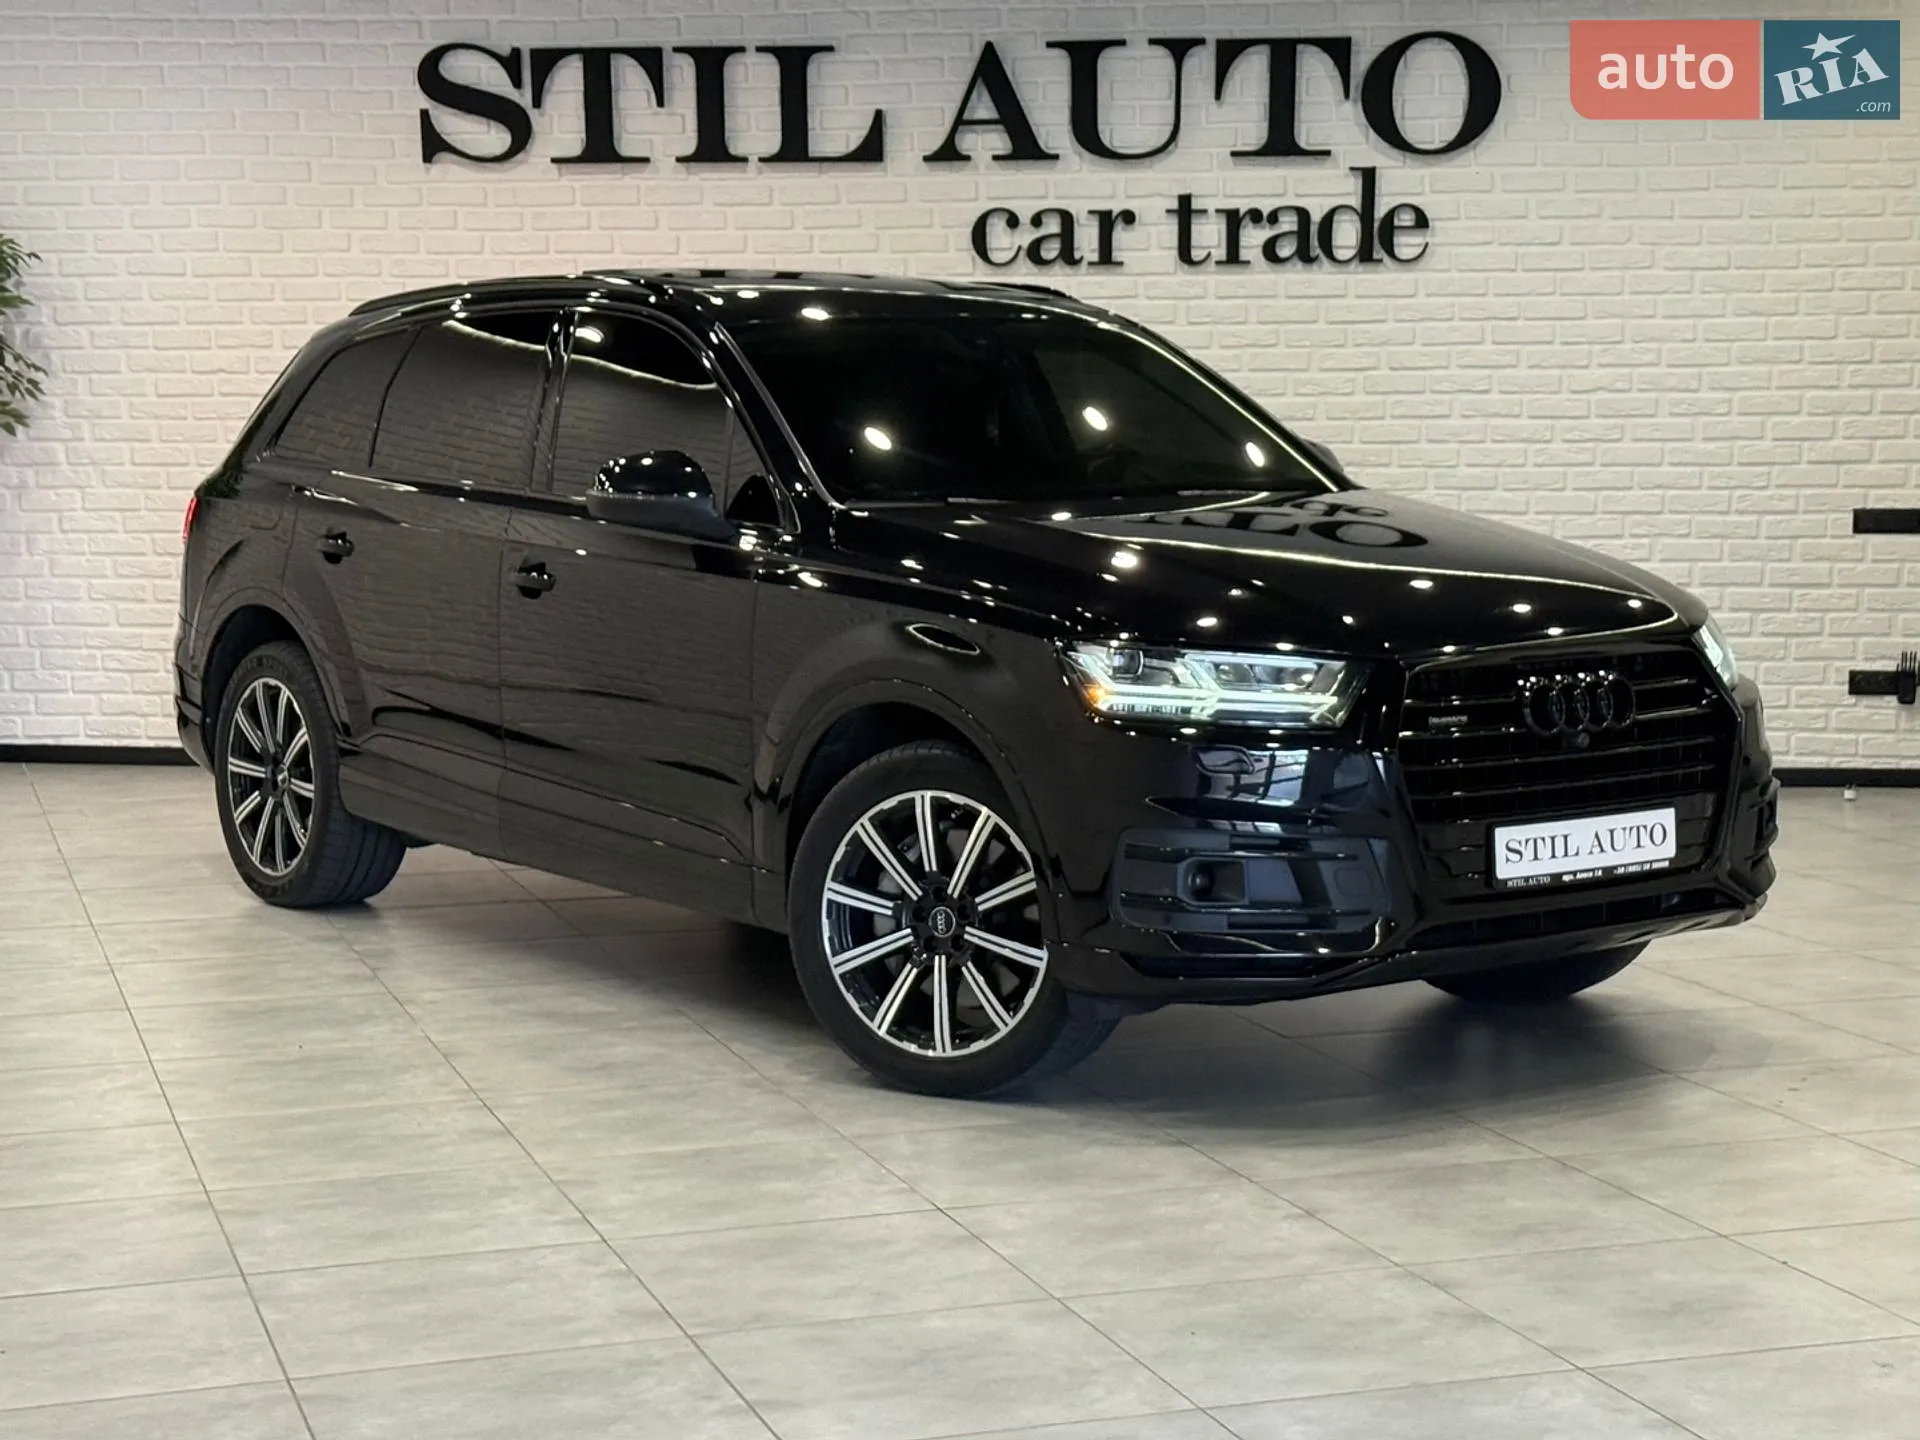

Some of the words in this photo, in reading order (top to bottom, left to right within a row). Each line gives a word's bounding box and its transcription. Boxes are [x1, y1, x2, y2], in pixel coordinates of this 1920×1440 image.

[417, 42, 885, 164] STIL
[922, 30, 1502, 162] AUTO
[971, 206, 1136, 267] car
[1165, 166, 1430, 266] trade
[1505, 832, 1581, 865] STIL
[1588, 822, 1668, 856] AUTO
